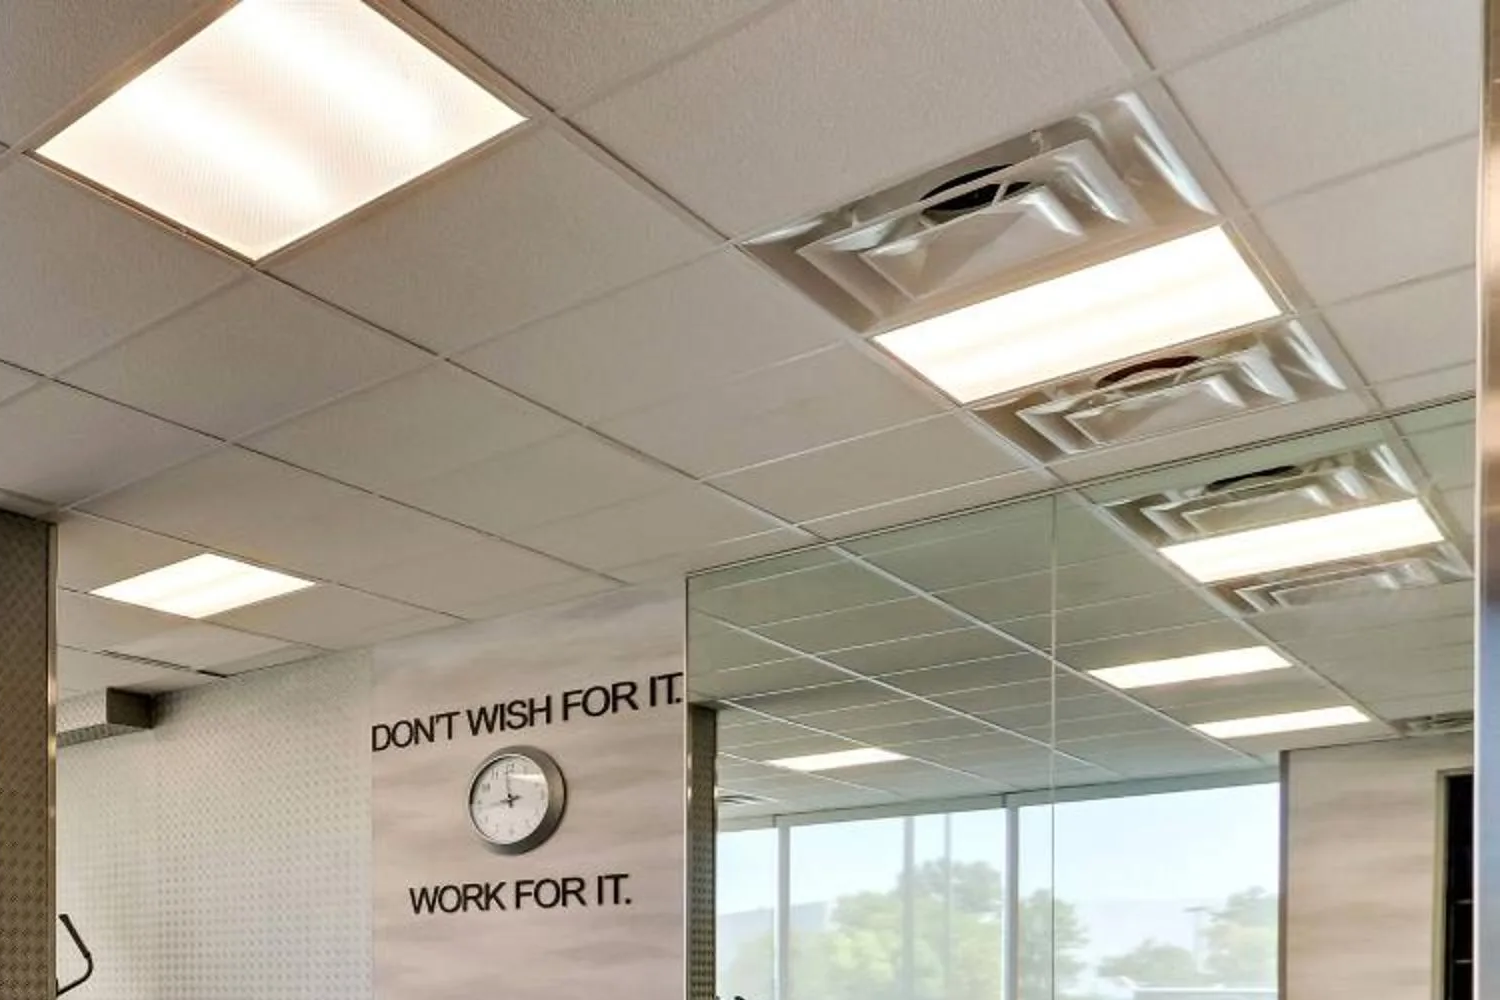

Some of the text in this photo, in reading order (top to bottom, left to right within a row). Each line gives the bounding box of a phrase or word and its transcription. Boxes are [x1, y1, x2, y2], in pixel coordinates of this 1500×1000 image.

[371, 671, 684, 752] DON'T WISH FOR IT.
[409, 873, 632, 914] WORK FOR IT.
